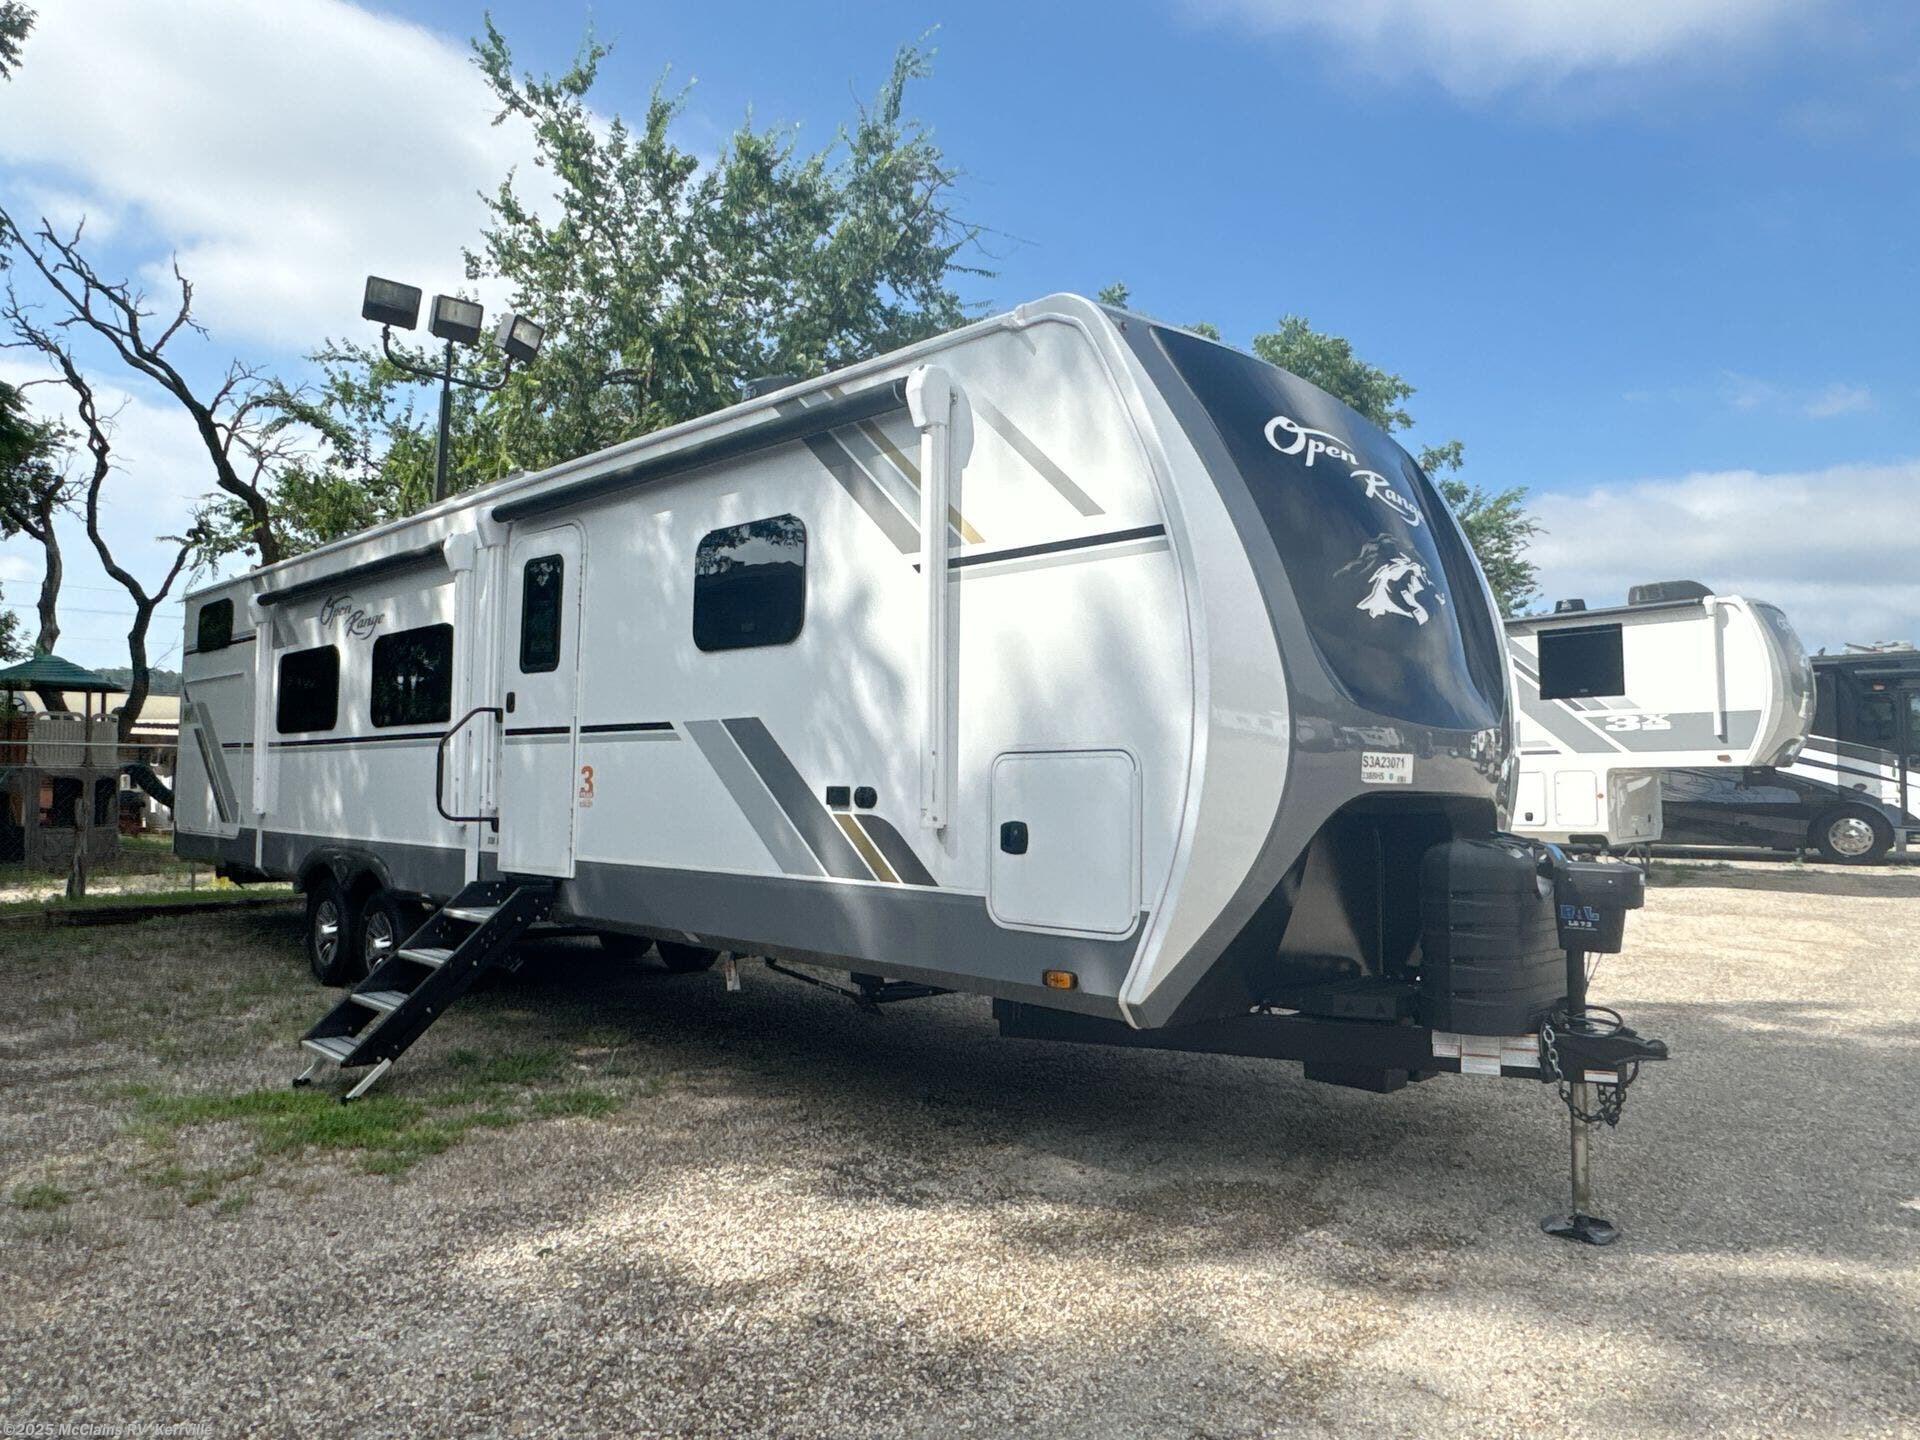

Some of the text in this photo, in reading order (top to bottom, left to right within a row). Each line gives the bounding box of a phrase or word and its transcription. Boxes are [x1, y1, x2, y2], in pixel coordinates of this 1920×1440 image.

[1263, 415, 1426, 527] Open Range
[320, 595, 386, 640] Open Range
[580, 765, 594, 793] 3
[1362, 755, 1405, 769] S3A23071
